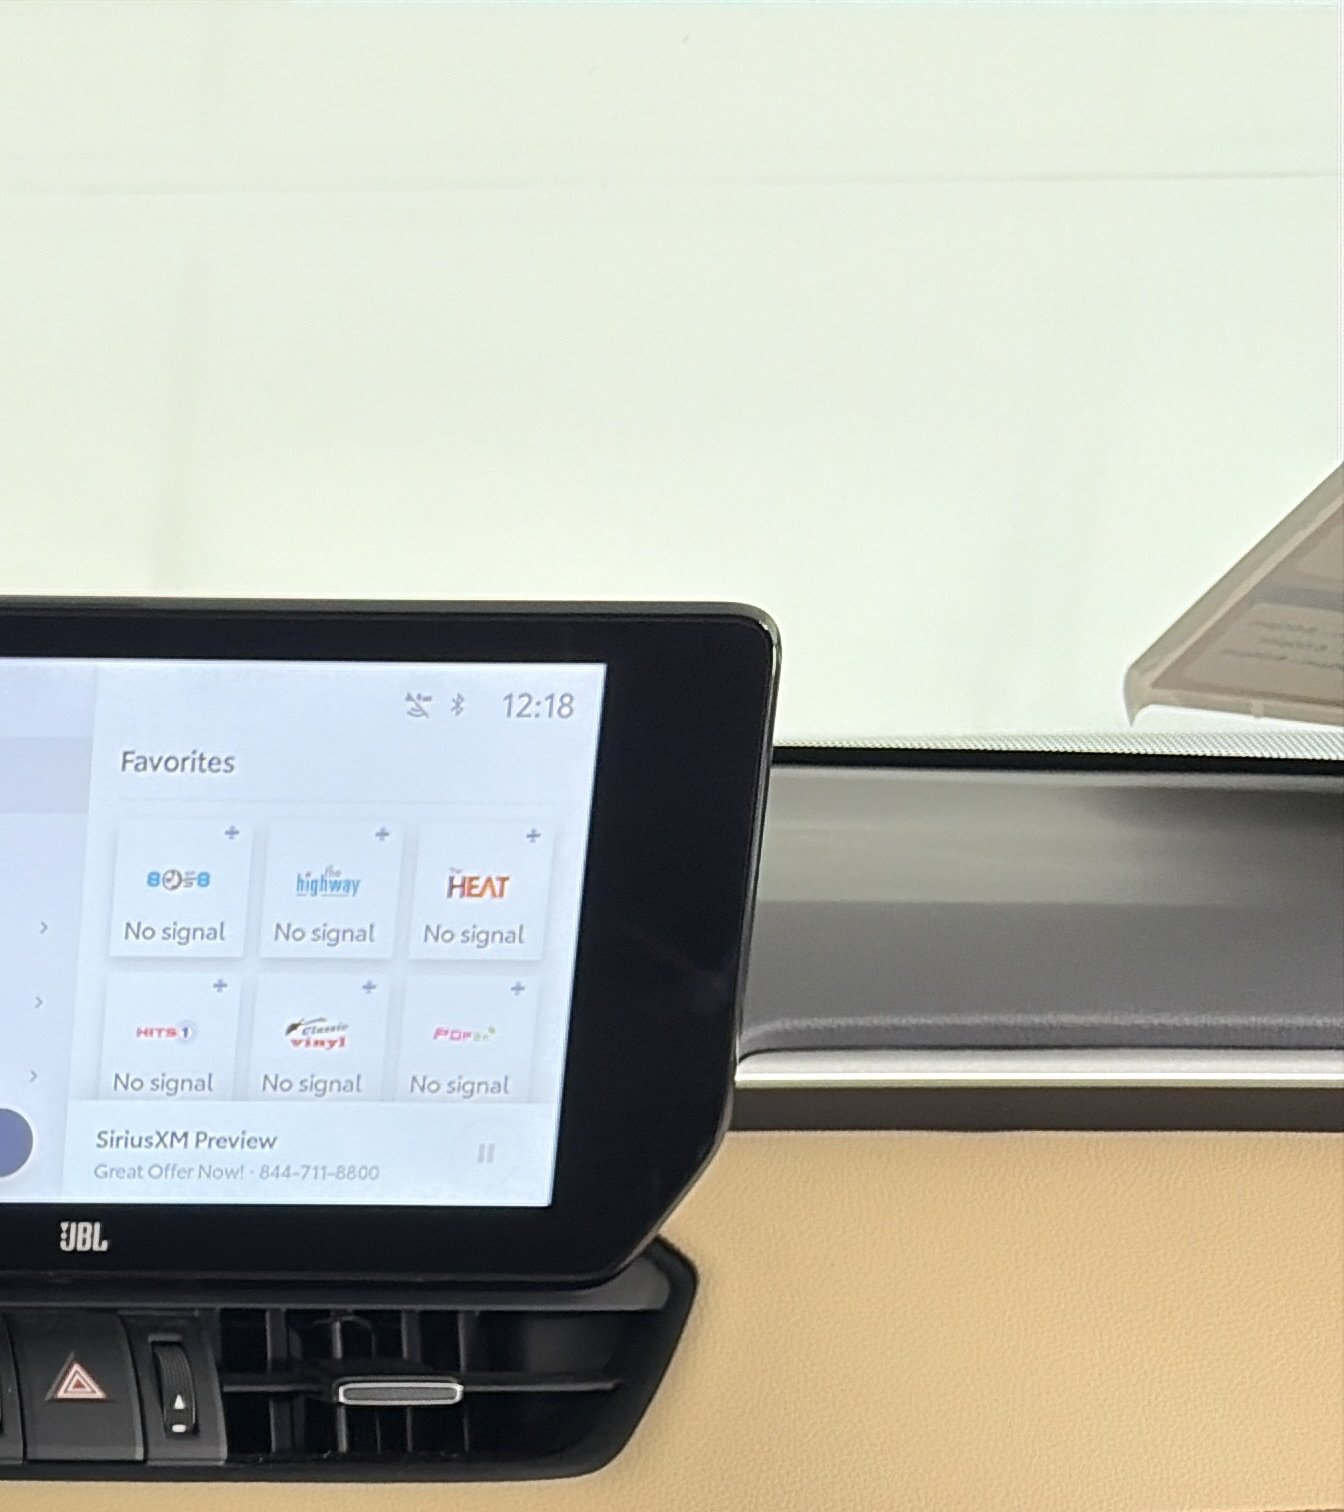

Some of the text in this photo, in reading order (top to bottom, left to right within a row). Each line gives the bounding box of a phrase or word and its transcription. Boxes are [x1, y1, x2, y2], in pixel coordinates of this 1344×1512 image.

[502, 691, 576, 719] 12:18
[119, 748, 237, 775] Favorites
[296, 869, 362, 898] highway
[446, 875, 511, 899] HEAT
[123, 921, 226, 945] No signal
[273, 922, 375, 946] No signal
[423, 924, 525, 949] No signal
[135, 1026, 178, 1039] HITS
[112, 1072, 214, 1098] No signal
[261, 1073, 363, 1098] No signal
[409, 1074, 510, 1100] No signal
[95, 1130, 278, 1152] SiriusXM Preview
[93, 1163, 381, 1182] Great Offer Now! 844-711-8800
[59, 1220, 109, 1252] JBL
